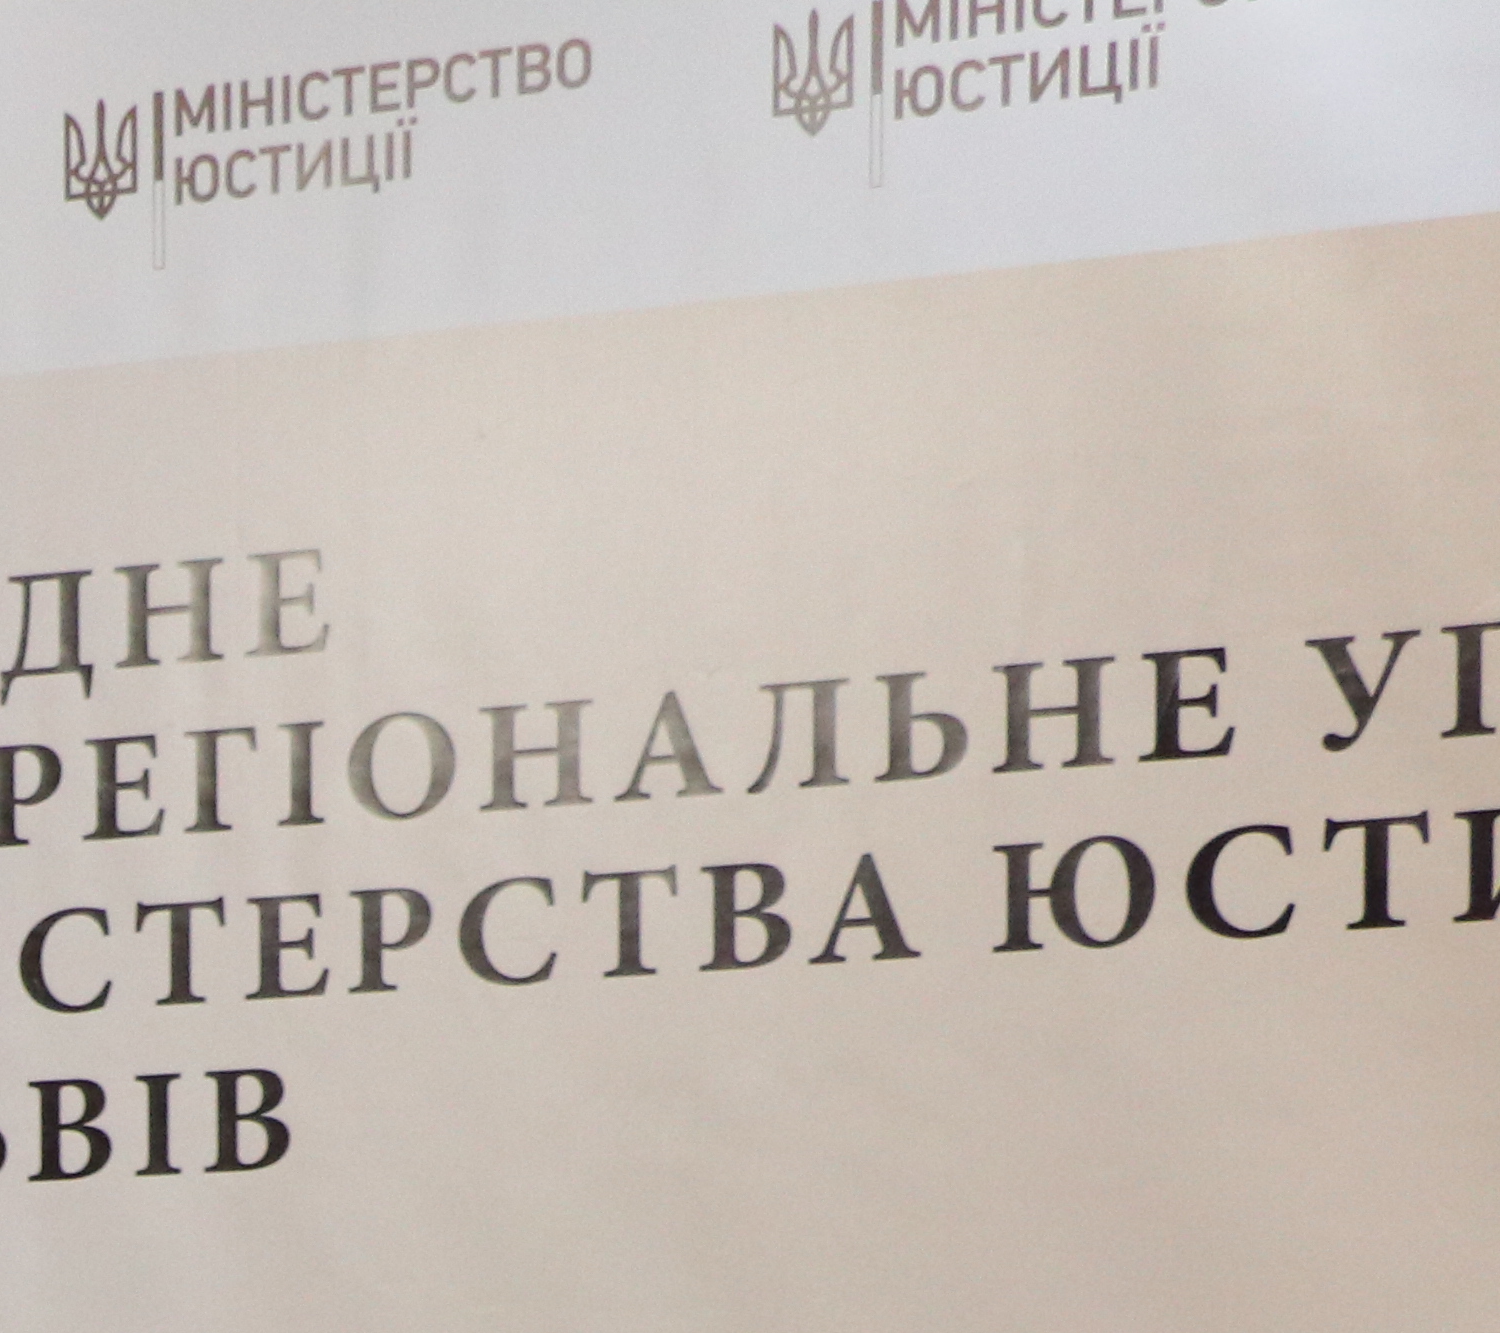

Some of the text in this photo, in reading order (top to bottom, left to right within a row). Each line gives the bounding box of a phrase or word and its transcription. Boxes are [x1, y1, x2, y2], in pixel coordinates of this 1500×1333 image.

[173, 39, 594, 136] МІНІСТЕРСТВО
[894, 22, 1165, 120] ЮСТИЦІЇ
[173, 121, 416, 205] ЮСТИЦІЇ
